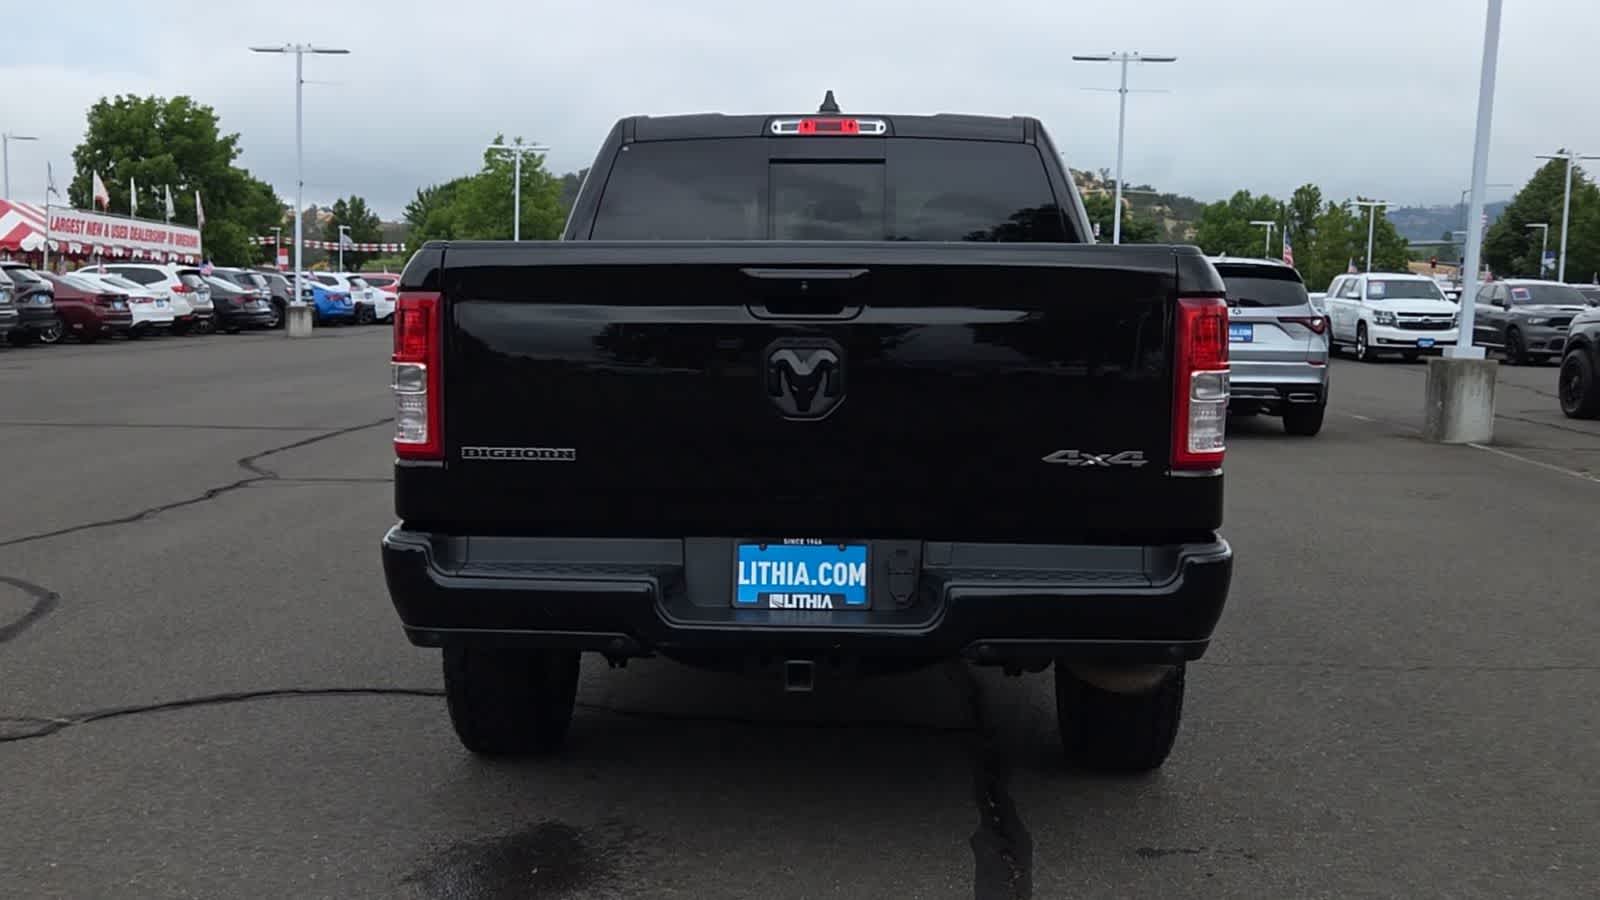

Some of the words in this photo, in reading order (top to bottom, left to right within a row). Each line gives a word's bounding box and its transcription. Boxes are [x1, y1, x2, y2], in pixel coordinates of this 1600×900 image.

[50, 216, 85, 235] LARGEST
[86, 221, 104, 236] NEW
[111, 224, 128, 239] USED
[130, 226, 166, 243] DEALERSHIP
[167, 232, 175, 245] IN
[783, 537, 804, 545] SINCE
[738, 560, 867, 587] LITHIA.COM
[783, 594, 833, 609] LITHIA
